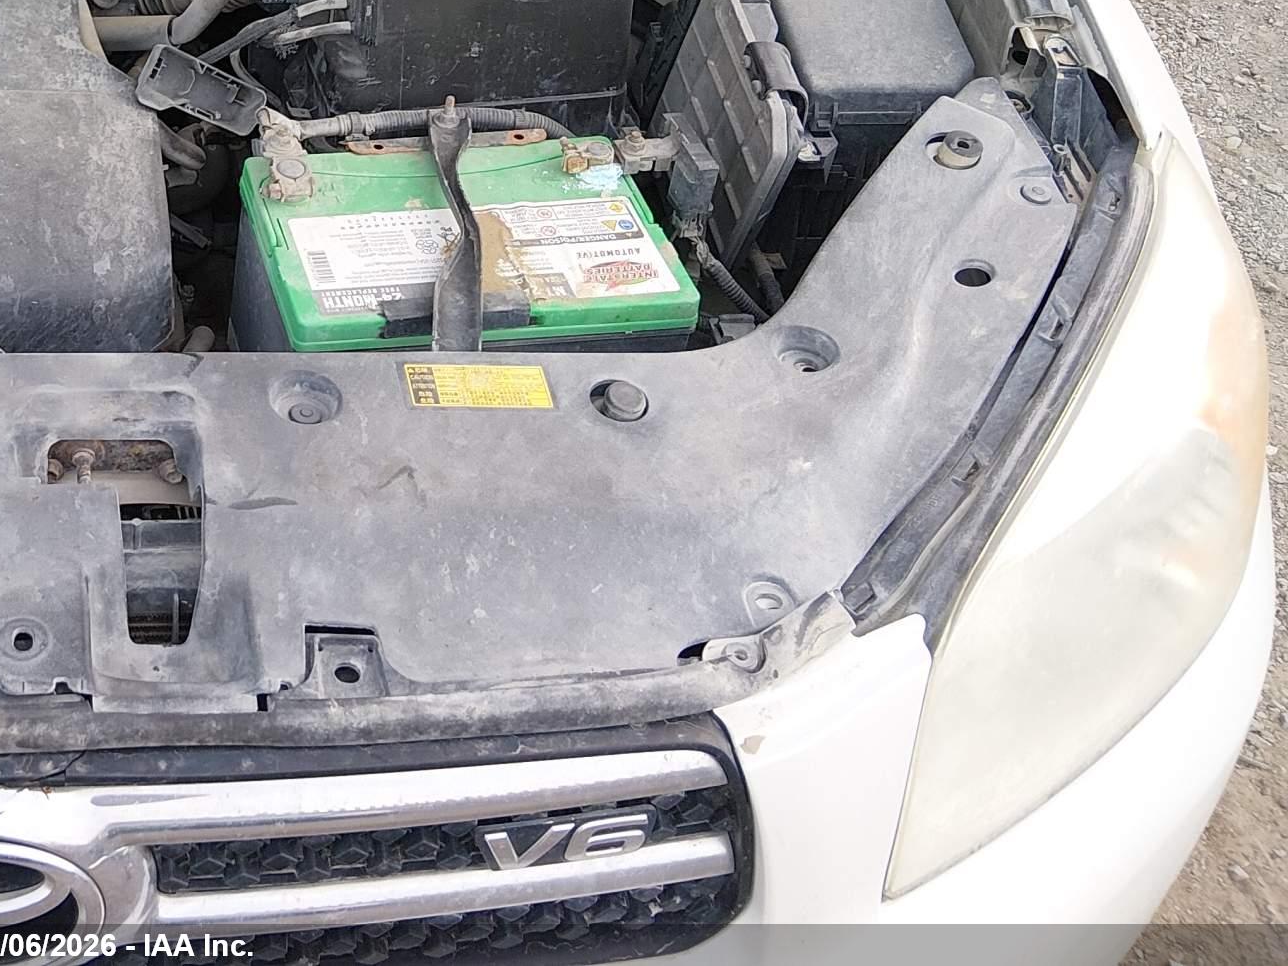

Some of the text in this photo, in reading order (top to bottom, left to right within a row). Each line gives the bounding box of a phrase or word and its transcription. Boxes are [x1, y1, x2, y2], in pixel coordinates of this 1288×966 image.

[576, 248, 641, 259] AUTOMOTIVE
[585, 262, 653, 274] BATTERIES
[584, 270, 659, 283] INTERSTATE
[484, 814, 648, 870] V6
